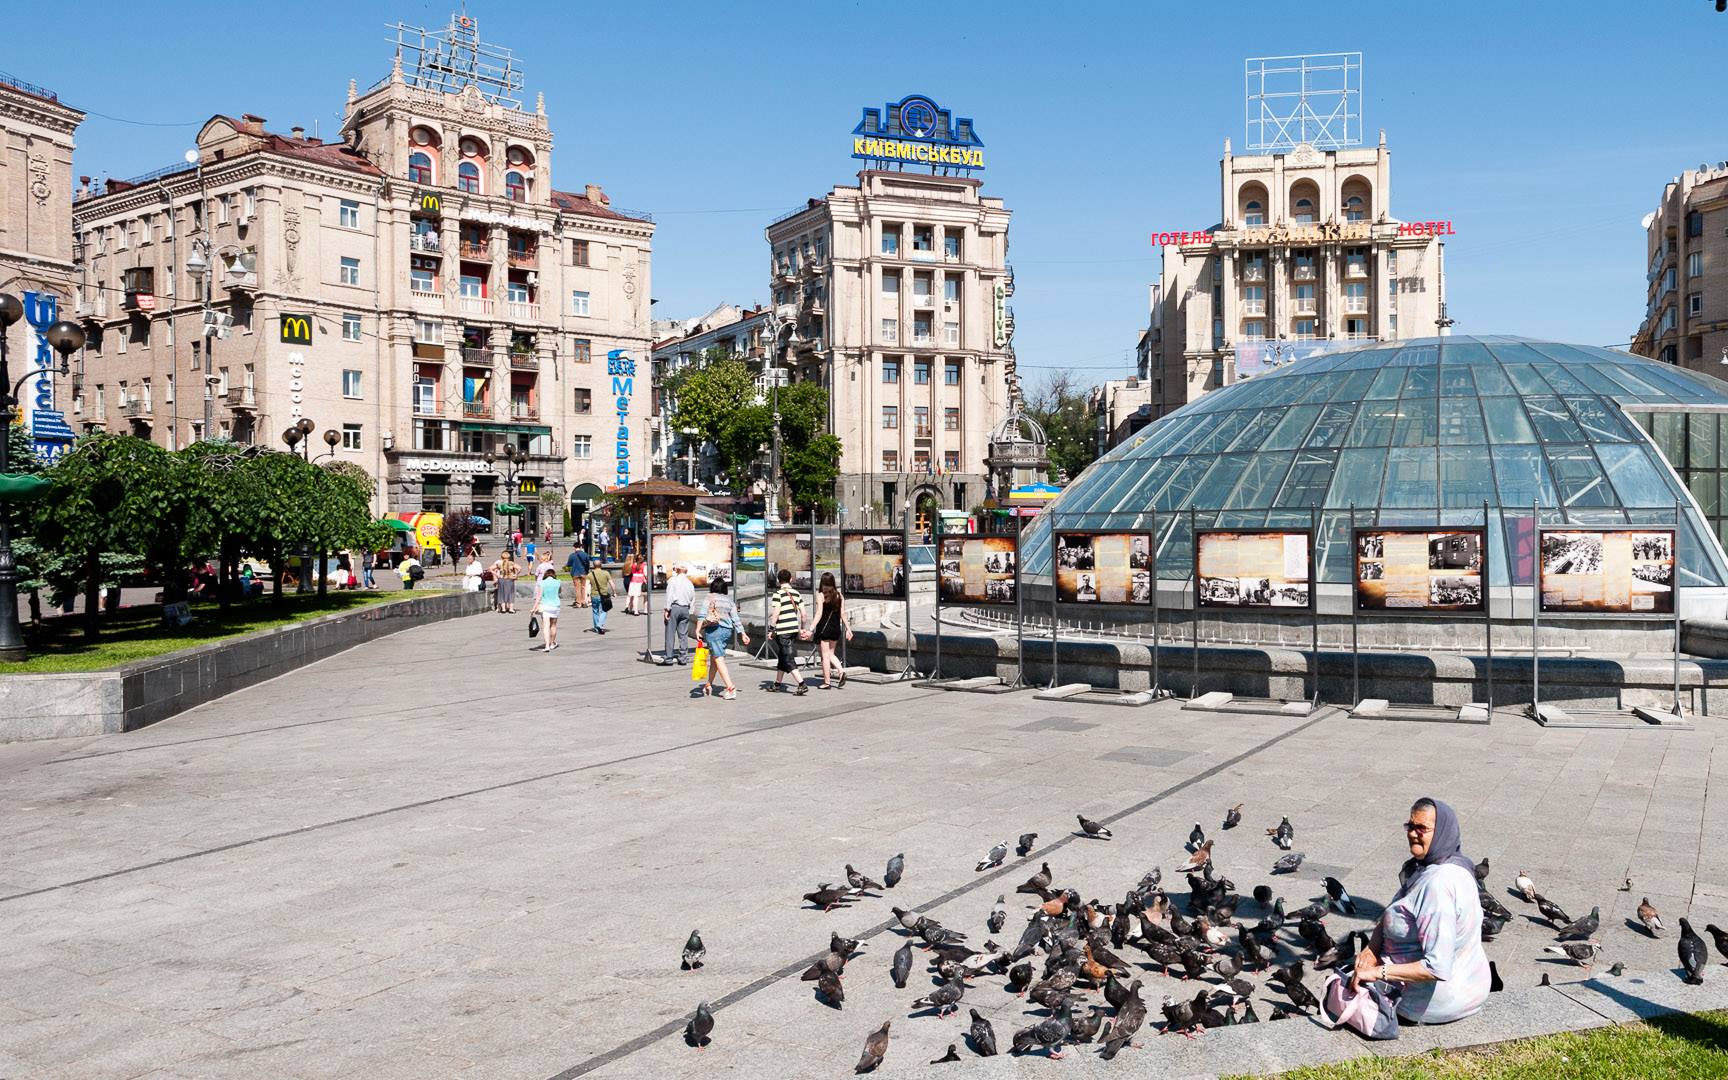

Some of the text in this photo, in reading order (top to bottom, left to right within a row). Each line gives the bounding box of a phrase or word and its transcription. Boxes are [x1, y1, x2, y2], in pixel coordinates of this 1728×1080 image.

[853, 138, 984, 166] КИЇВМІСЬКБУД
[469, 208, 549, 231] McDonald's
[1399, 221, 1456, 237] HOTEL
[1151, 230, 1214, 246] ГОТЕЛЬ
